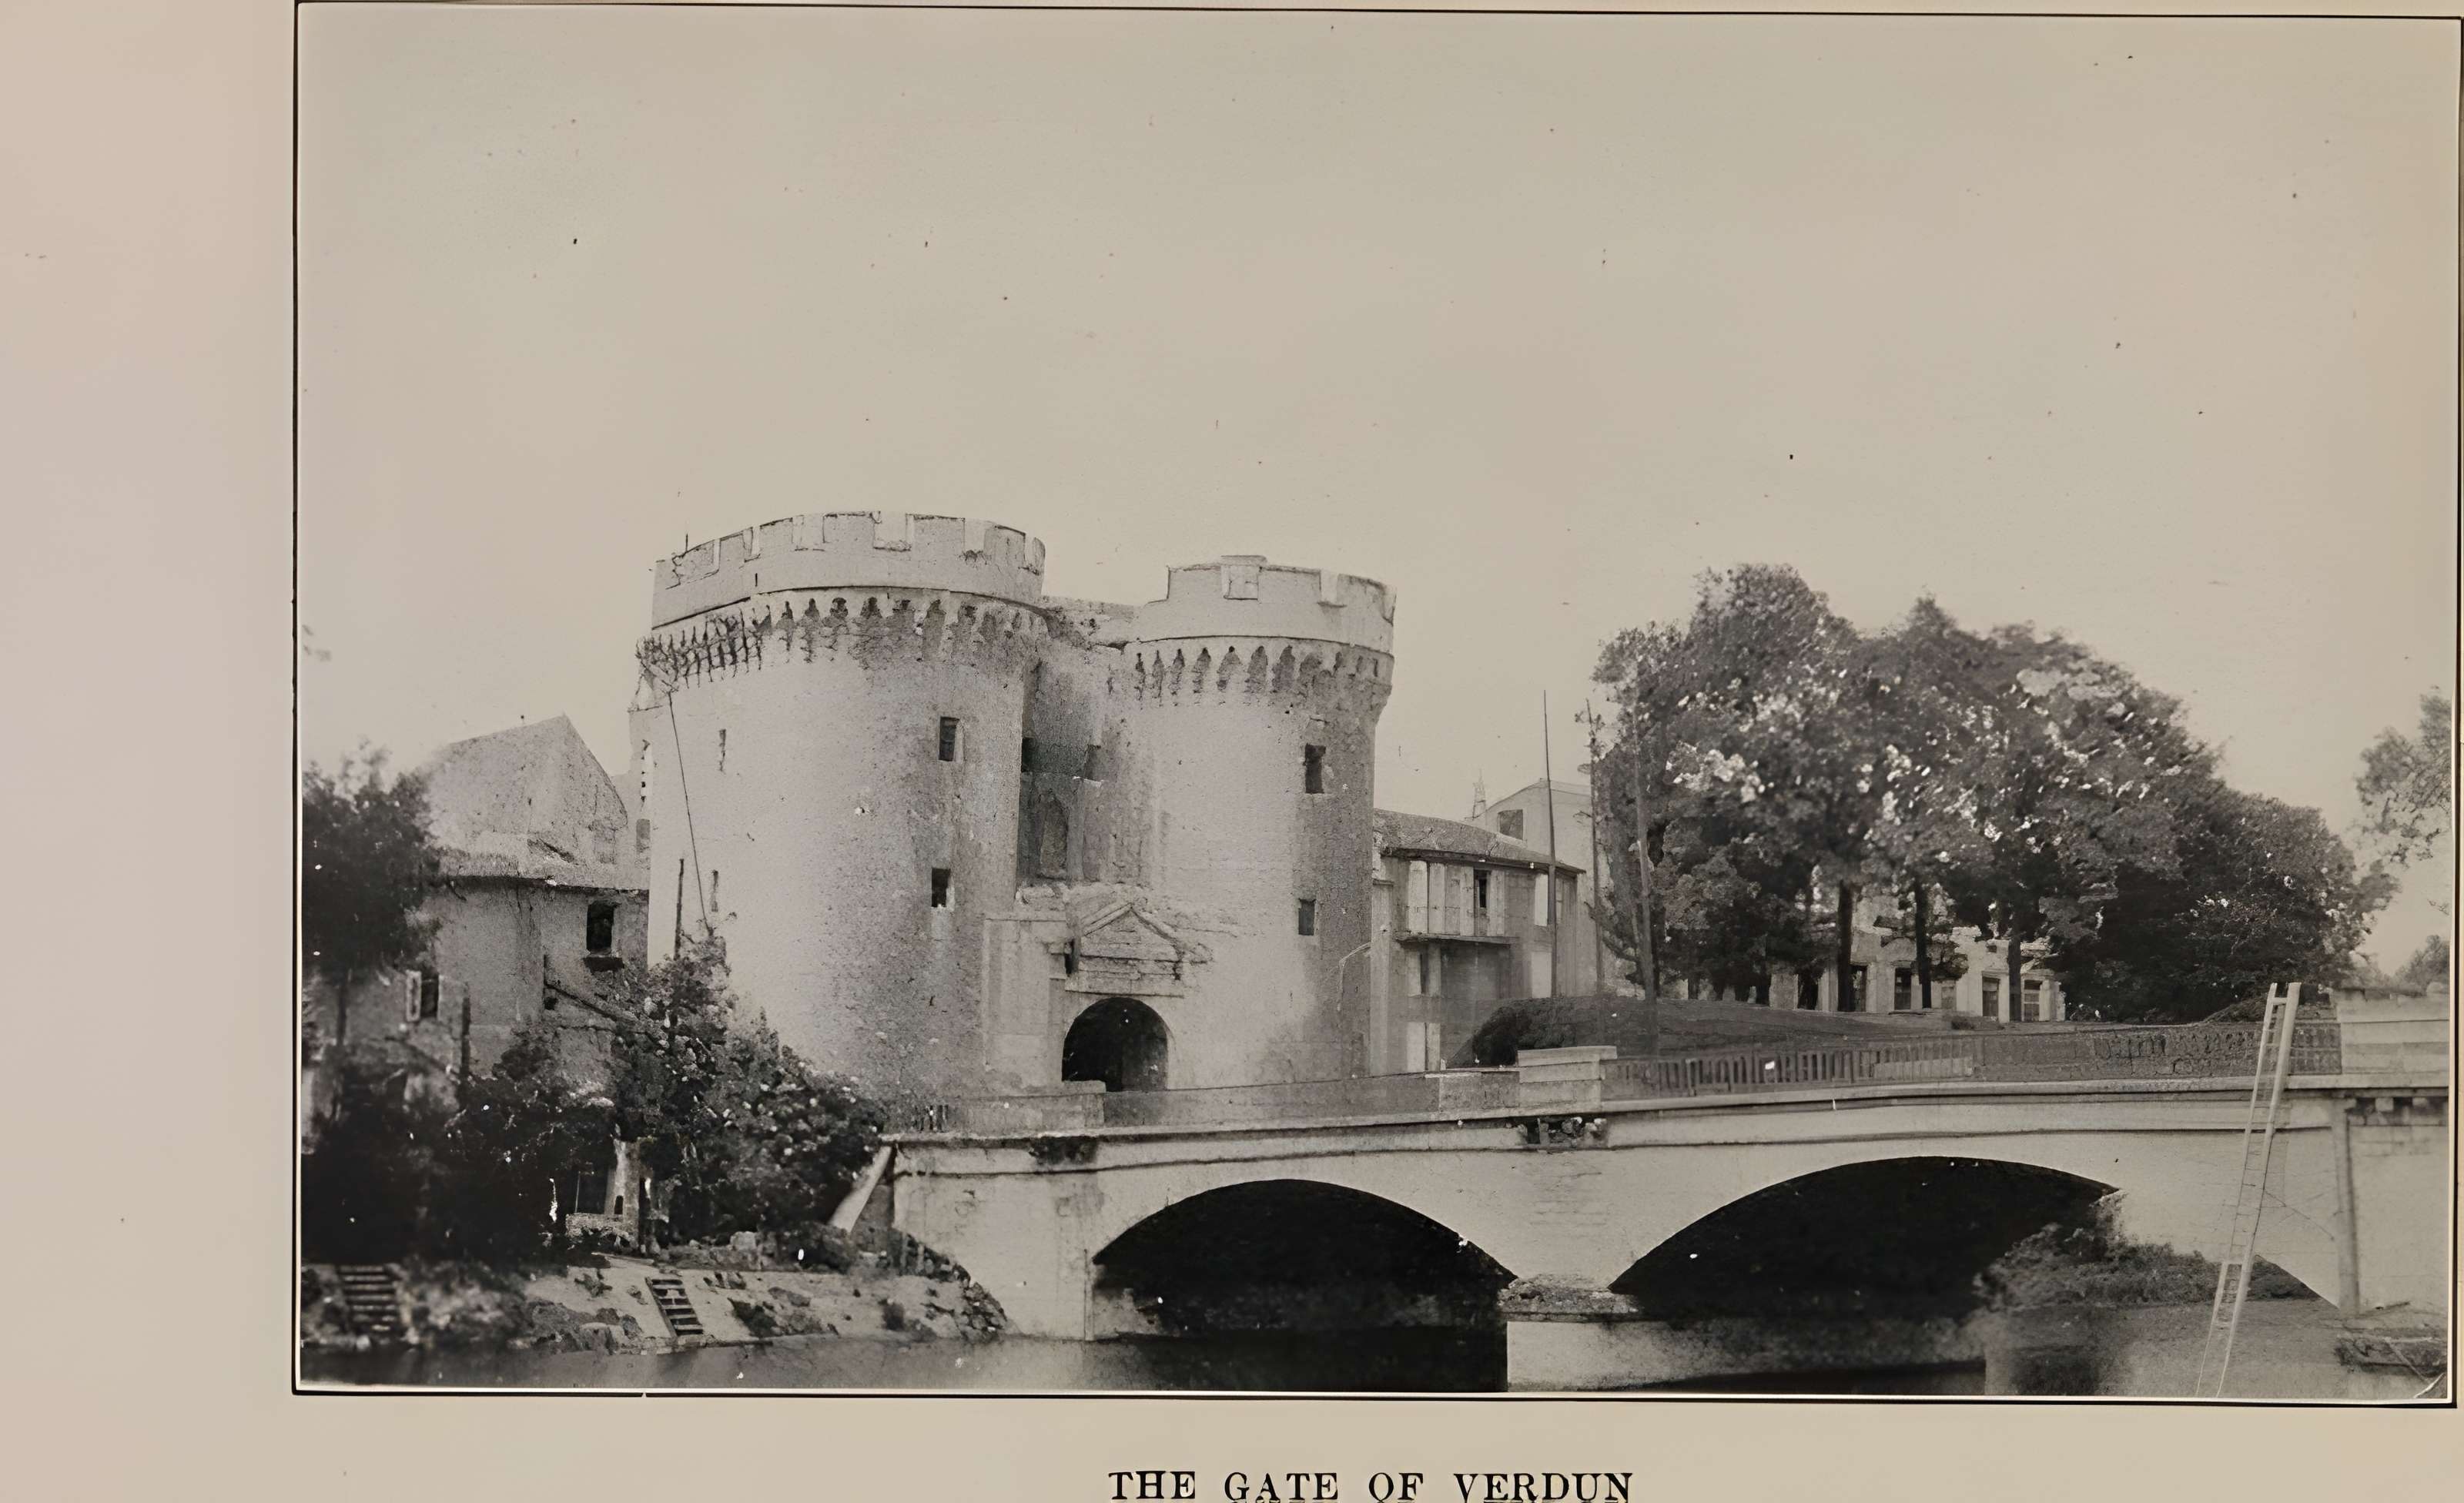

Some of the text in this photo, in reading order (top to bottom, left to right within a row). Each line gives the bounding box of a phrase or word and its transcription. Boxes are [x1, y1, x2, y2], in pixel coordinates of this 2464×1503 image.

[1108, 1470, 1633, 1502] THE GATE OF VERDUN
